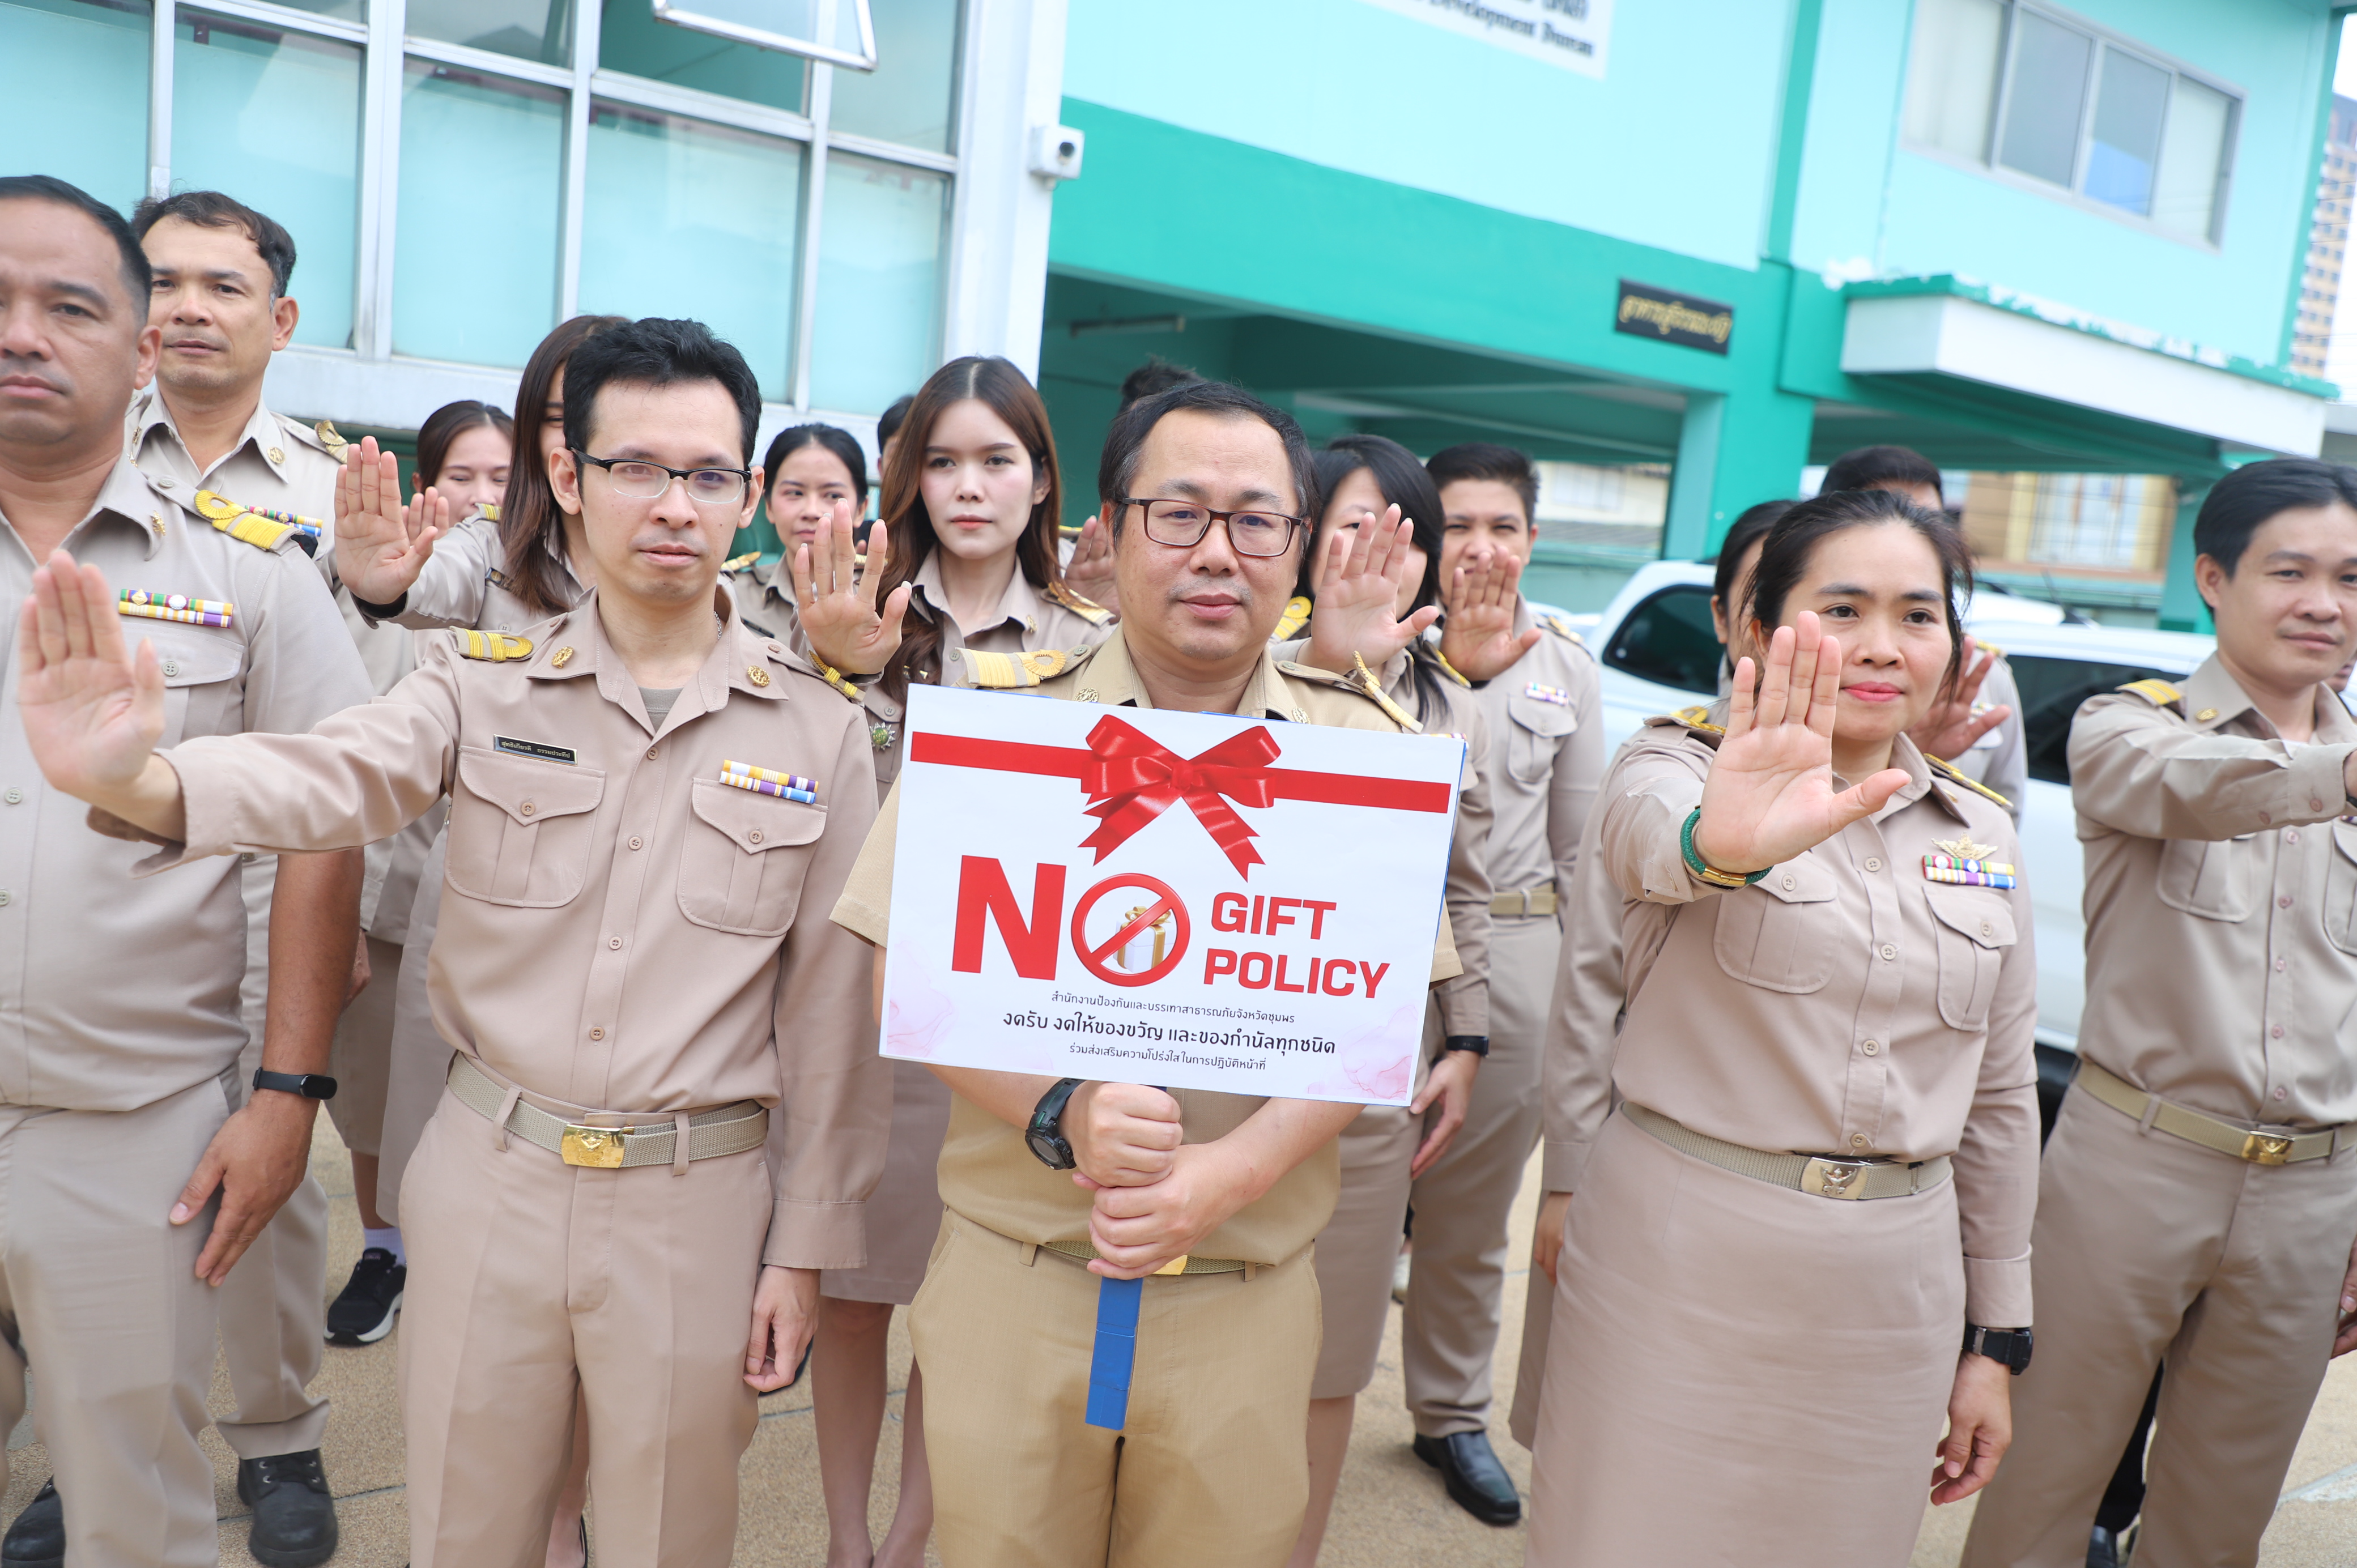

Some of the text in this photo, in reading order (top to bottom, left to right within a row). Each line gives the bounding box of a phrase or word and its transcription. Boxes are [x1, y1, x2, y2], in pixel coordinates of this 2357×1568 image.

[1211, 891, 1337, 941] GIFT
[1203, 948, 1391, 999] POLICY
[1051, 990, 1295, 1025] สำนักงานป้องกันและบรรเทาสาธารณภัยจังหวัดชุมพร
[1003, 1009, 1336, 1057] งดรับ งดให้ของขวัญ และของกำนัลทุกชนิด
